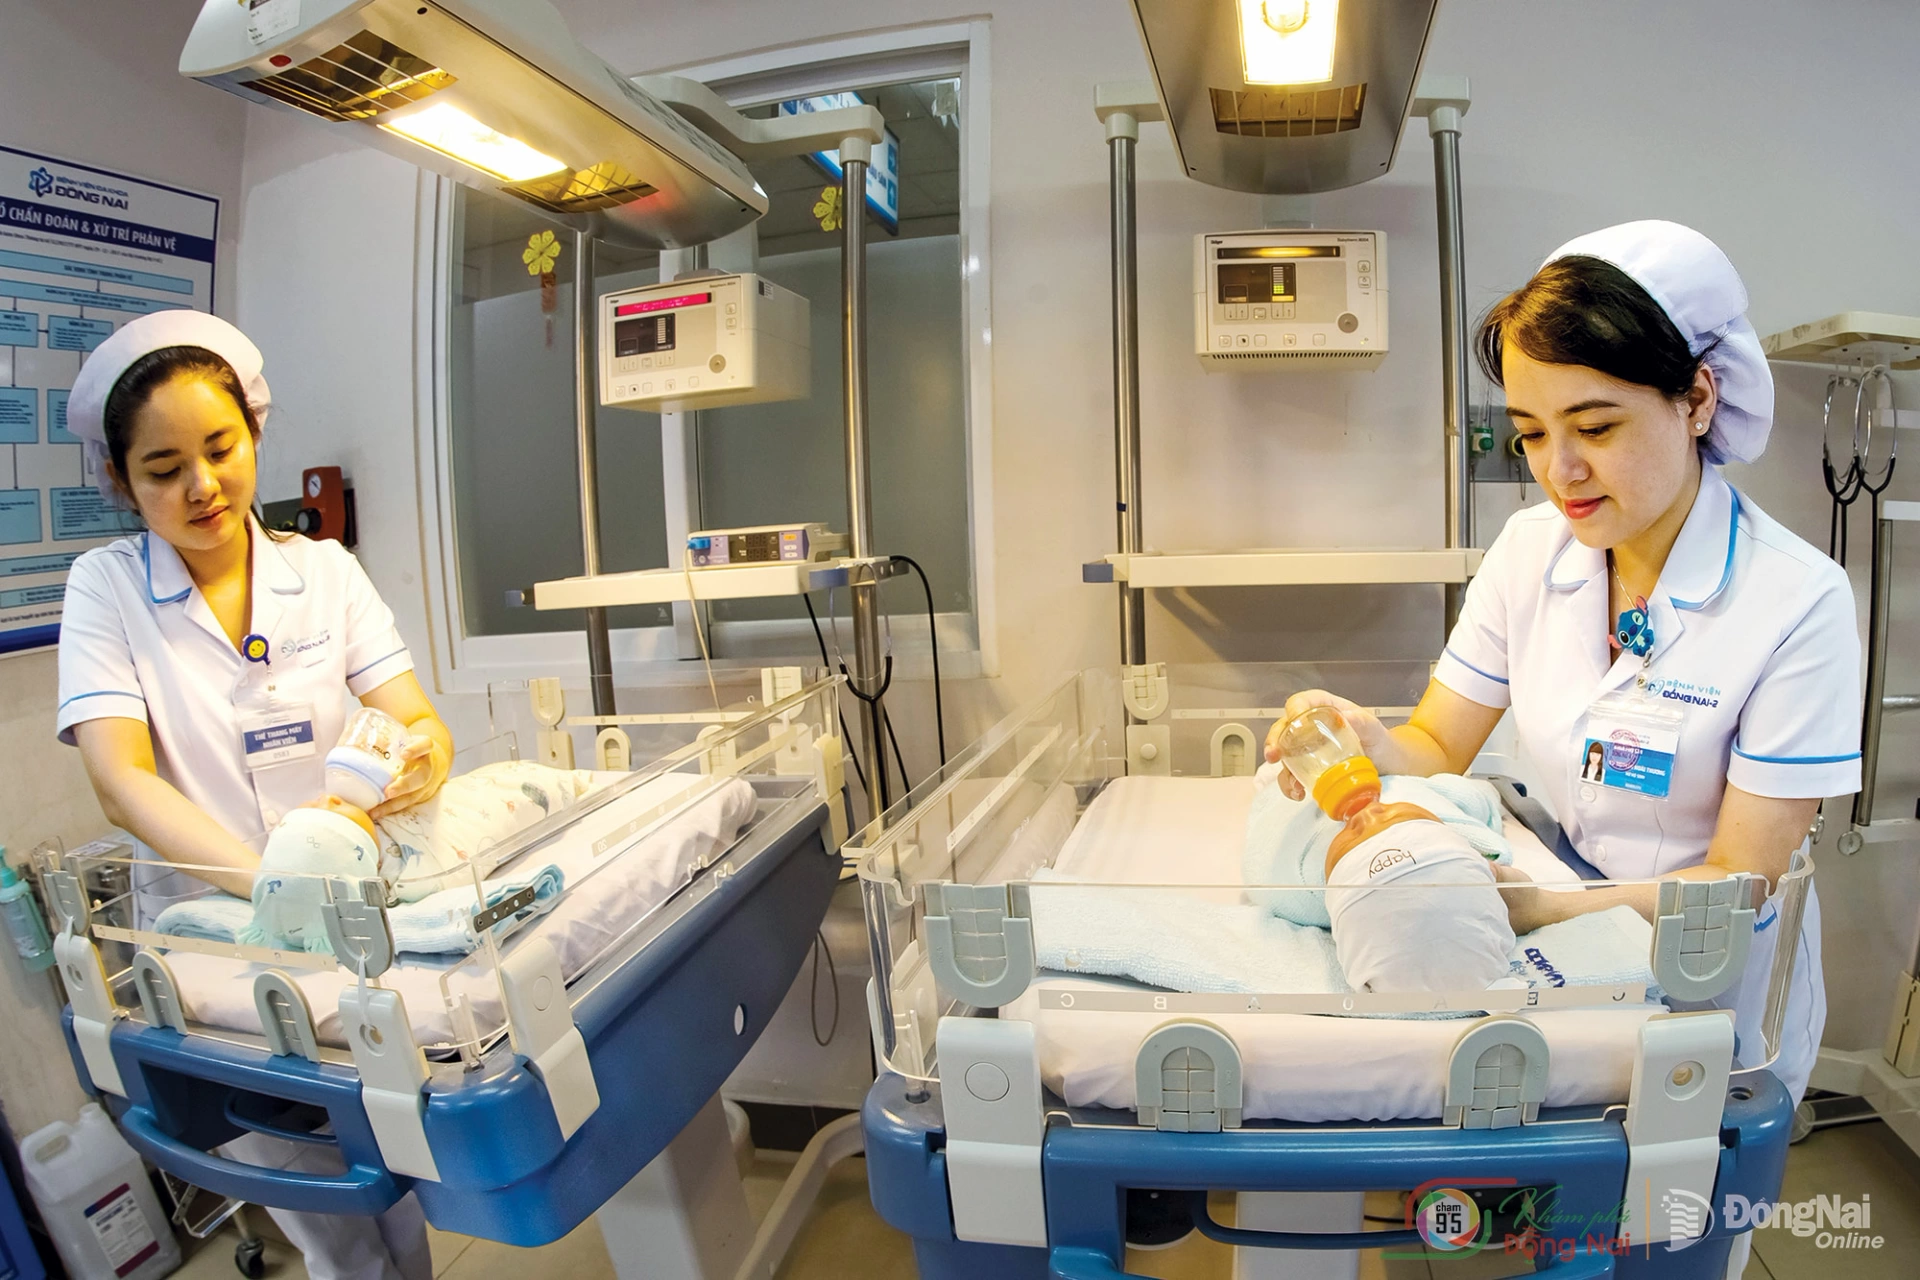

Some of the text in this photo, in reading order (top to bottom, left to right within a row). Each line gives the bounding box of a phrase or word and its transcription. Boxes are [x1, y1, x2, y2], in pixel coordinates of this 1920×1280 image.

[101, 197, 129, 210] NAI
[81, 220, 91, 234] &
[1369, 848, 1416, 878] happy
